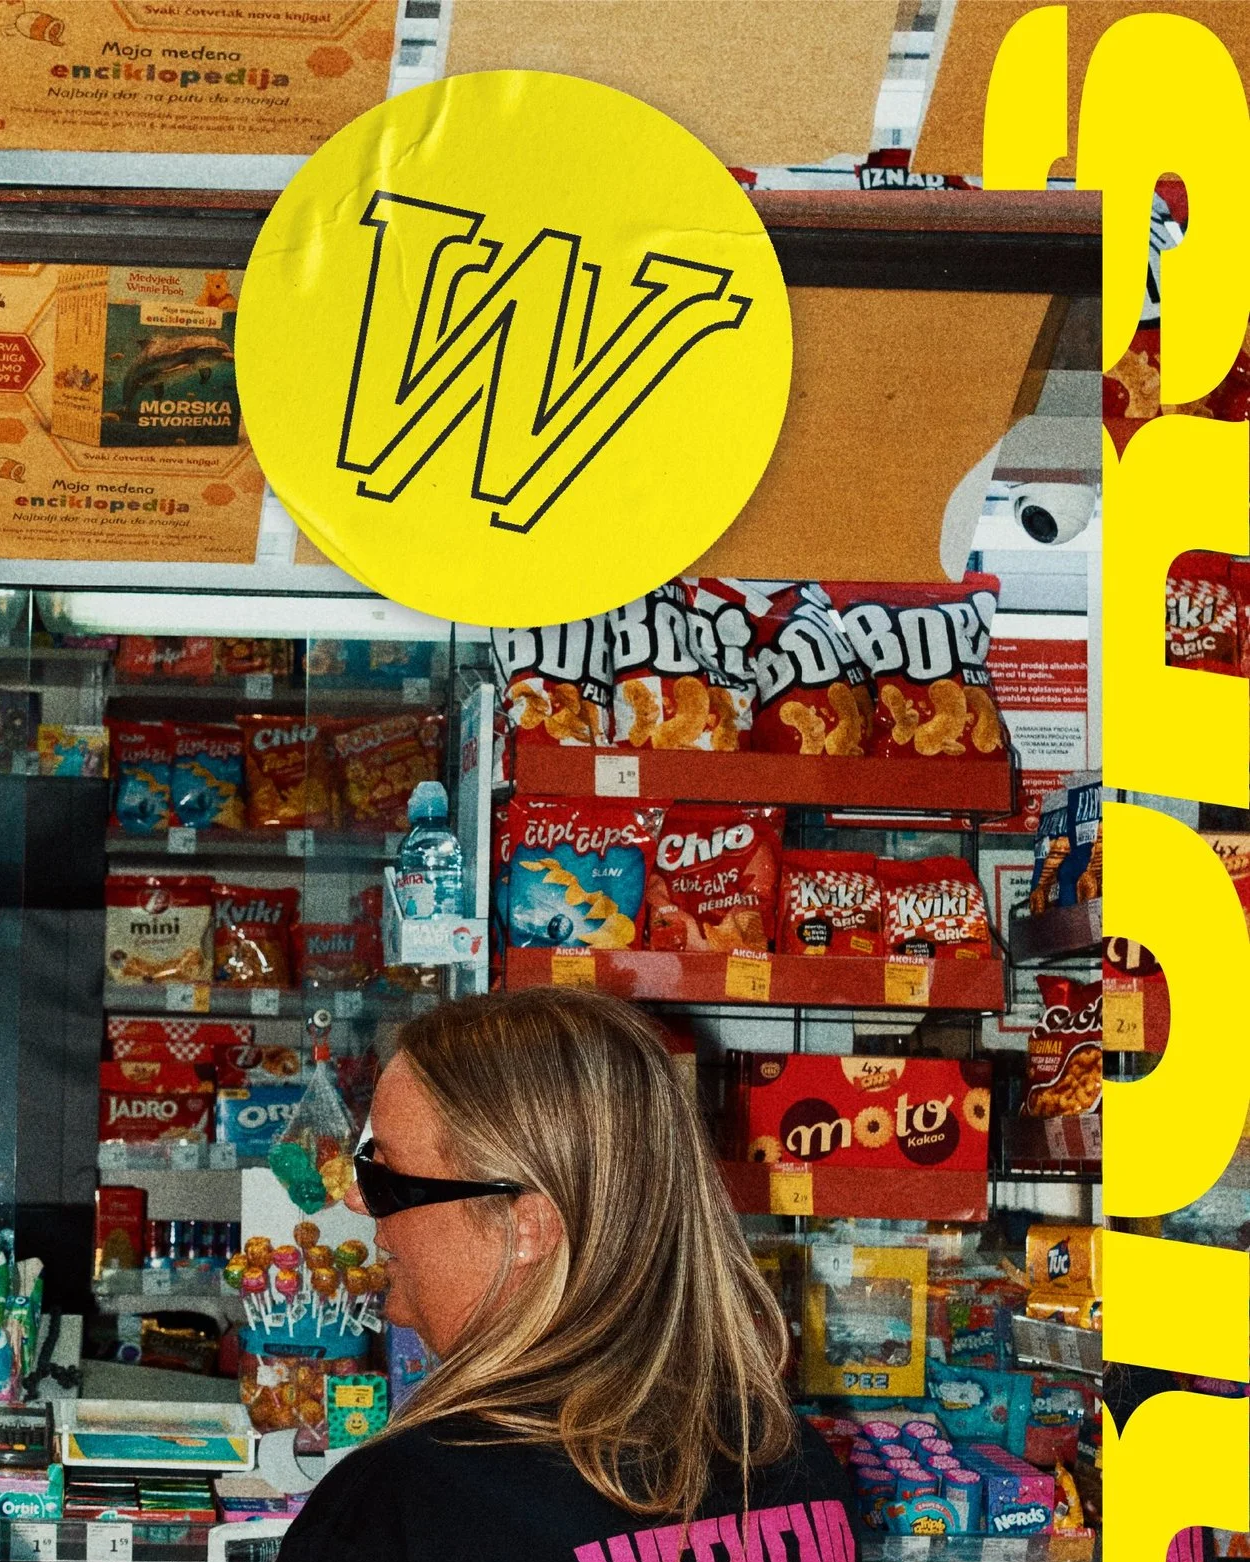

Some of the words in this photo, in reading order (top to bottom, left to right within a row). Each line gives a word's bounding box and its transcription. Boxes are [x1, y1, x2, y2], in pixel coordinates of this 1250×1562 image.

[102, 41, 152, 59] Moja
[51, 62, 289, 89] enciklopedija
[862, 167, 944, 188] IZNAD
[139, 399, 232, 415] MORSKA
[138, 415, 231, 428] STVORENJA
[52, 478, 90, 494] Moja
[96, 480, 154, 495] medena
[14, 494, 190, 515] enciklopedija
[254, 725, 317, 751] Chio
[656, 824, 754, 871] Chio
[592, 867, 623, 878] SLANI
[798, 877, 866, 909] Kviki
[215, 899, 282, 926] Kviki
[898, 888, 968, 928] Kviki
[130, 915, 180, 935] mini
[555, 948, 591, 957] AKCIJA
[732, 948, 768, 960] AKCIJA
[889, 955, 925, 966] AKCIJA
[861, 1061, 883, 1075] 4x
[108, 1096, 178, 1126] JADRO
[907, 1131, 946, 1149] Kakao
[1047, 1251, 1069, 1276] TUC
[843, 1372, 889, 1389] PEZ
[2, 1501, 40, 1516] Orbit
[994, 1508, 1046, 1533] Nerds
